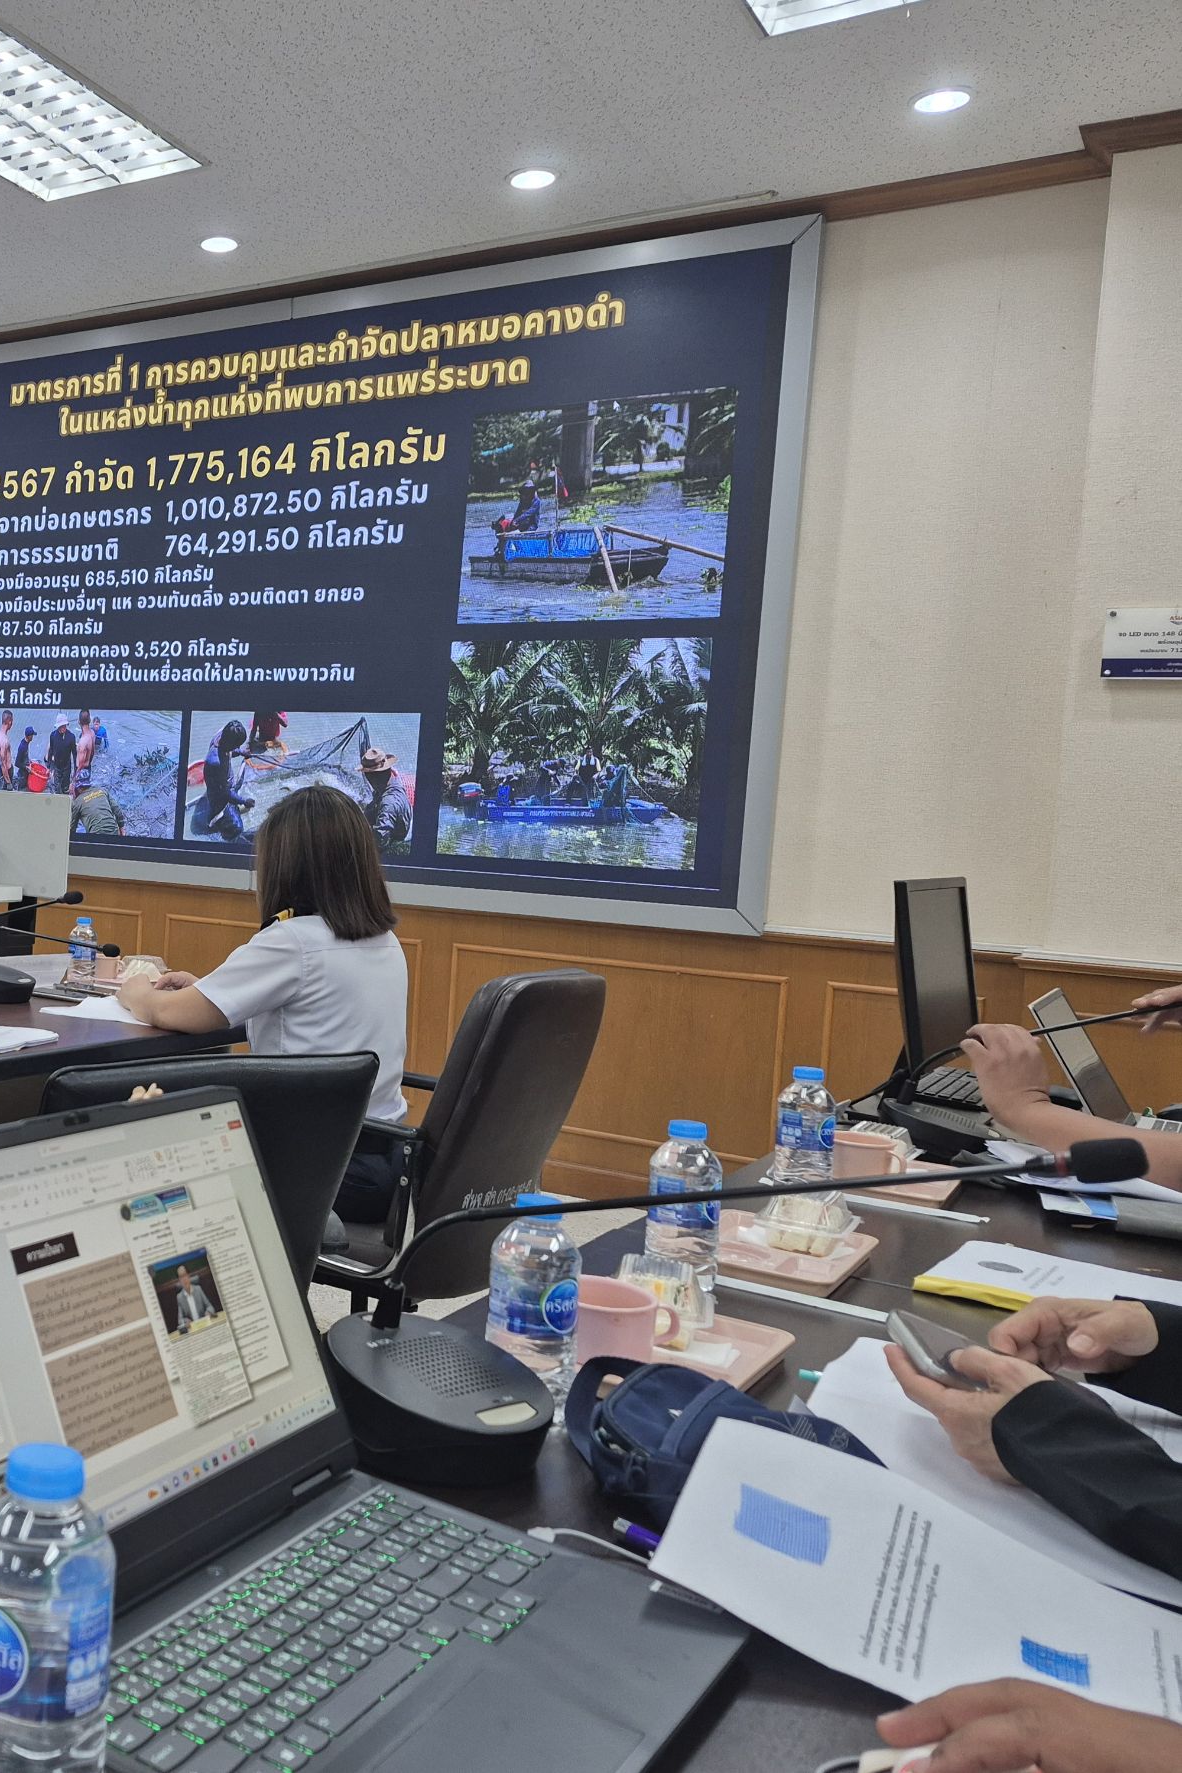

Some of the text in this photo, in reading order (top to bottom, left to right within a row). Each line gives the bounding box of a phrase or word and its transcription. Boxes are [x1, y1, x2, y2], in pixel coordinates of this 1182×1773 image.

[11, 293, 624, 406] มาตรการที่ 1 การควบคุมและกำจัดปลาหมอคางดำ
[59, 357, 529, 436] ในแหล่งน้ำทุกแห่งที่พบการแพร่ระบาด
[65, 456, 135, 495] กำจัด
[146, 442, 297, 490] 1,775,164
[310, 426, 447, 472] กิโลกรัม
[165, 487, 323, 525] 1,010,872.50
[330, 477, 429, 511] กิโลกรัม
[164, 525, 300, 558] 764,291.50
[307, 517, 405, 549] กิโลกรัม
[84, 568, 149, 588] 685,510
[154, 563, 214, 585] กิโลกรัม
[111, 595, 133, 611] แห
[228, 586, 309, 607] อวนติดตา
[314, 586, 366, 604] ยกยอ
[48, 616, 104, 636] กิโลกรัม
[134, 640, 183, 660] 3,520
[187, 637, 250, 657] กิโลกรัม
[9, 686, 62, 706] กิโลกรัม
